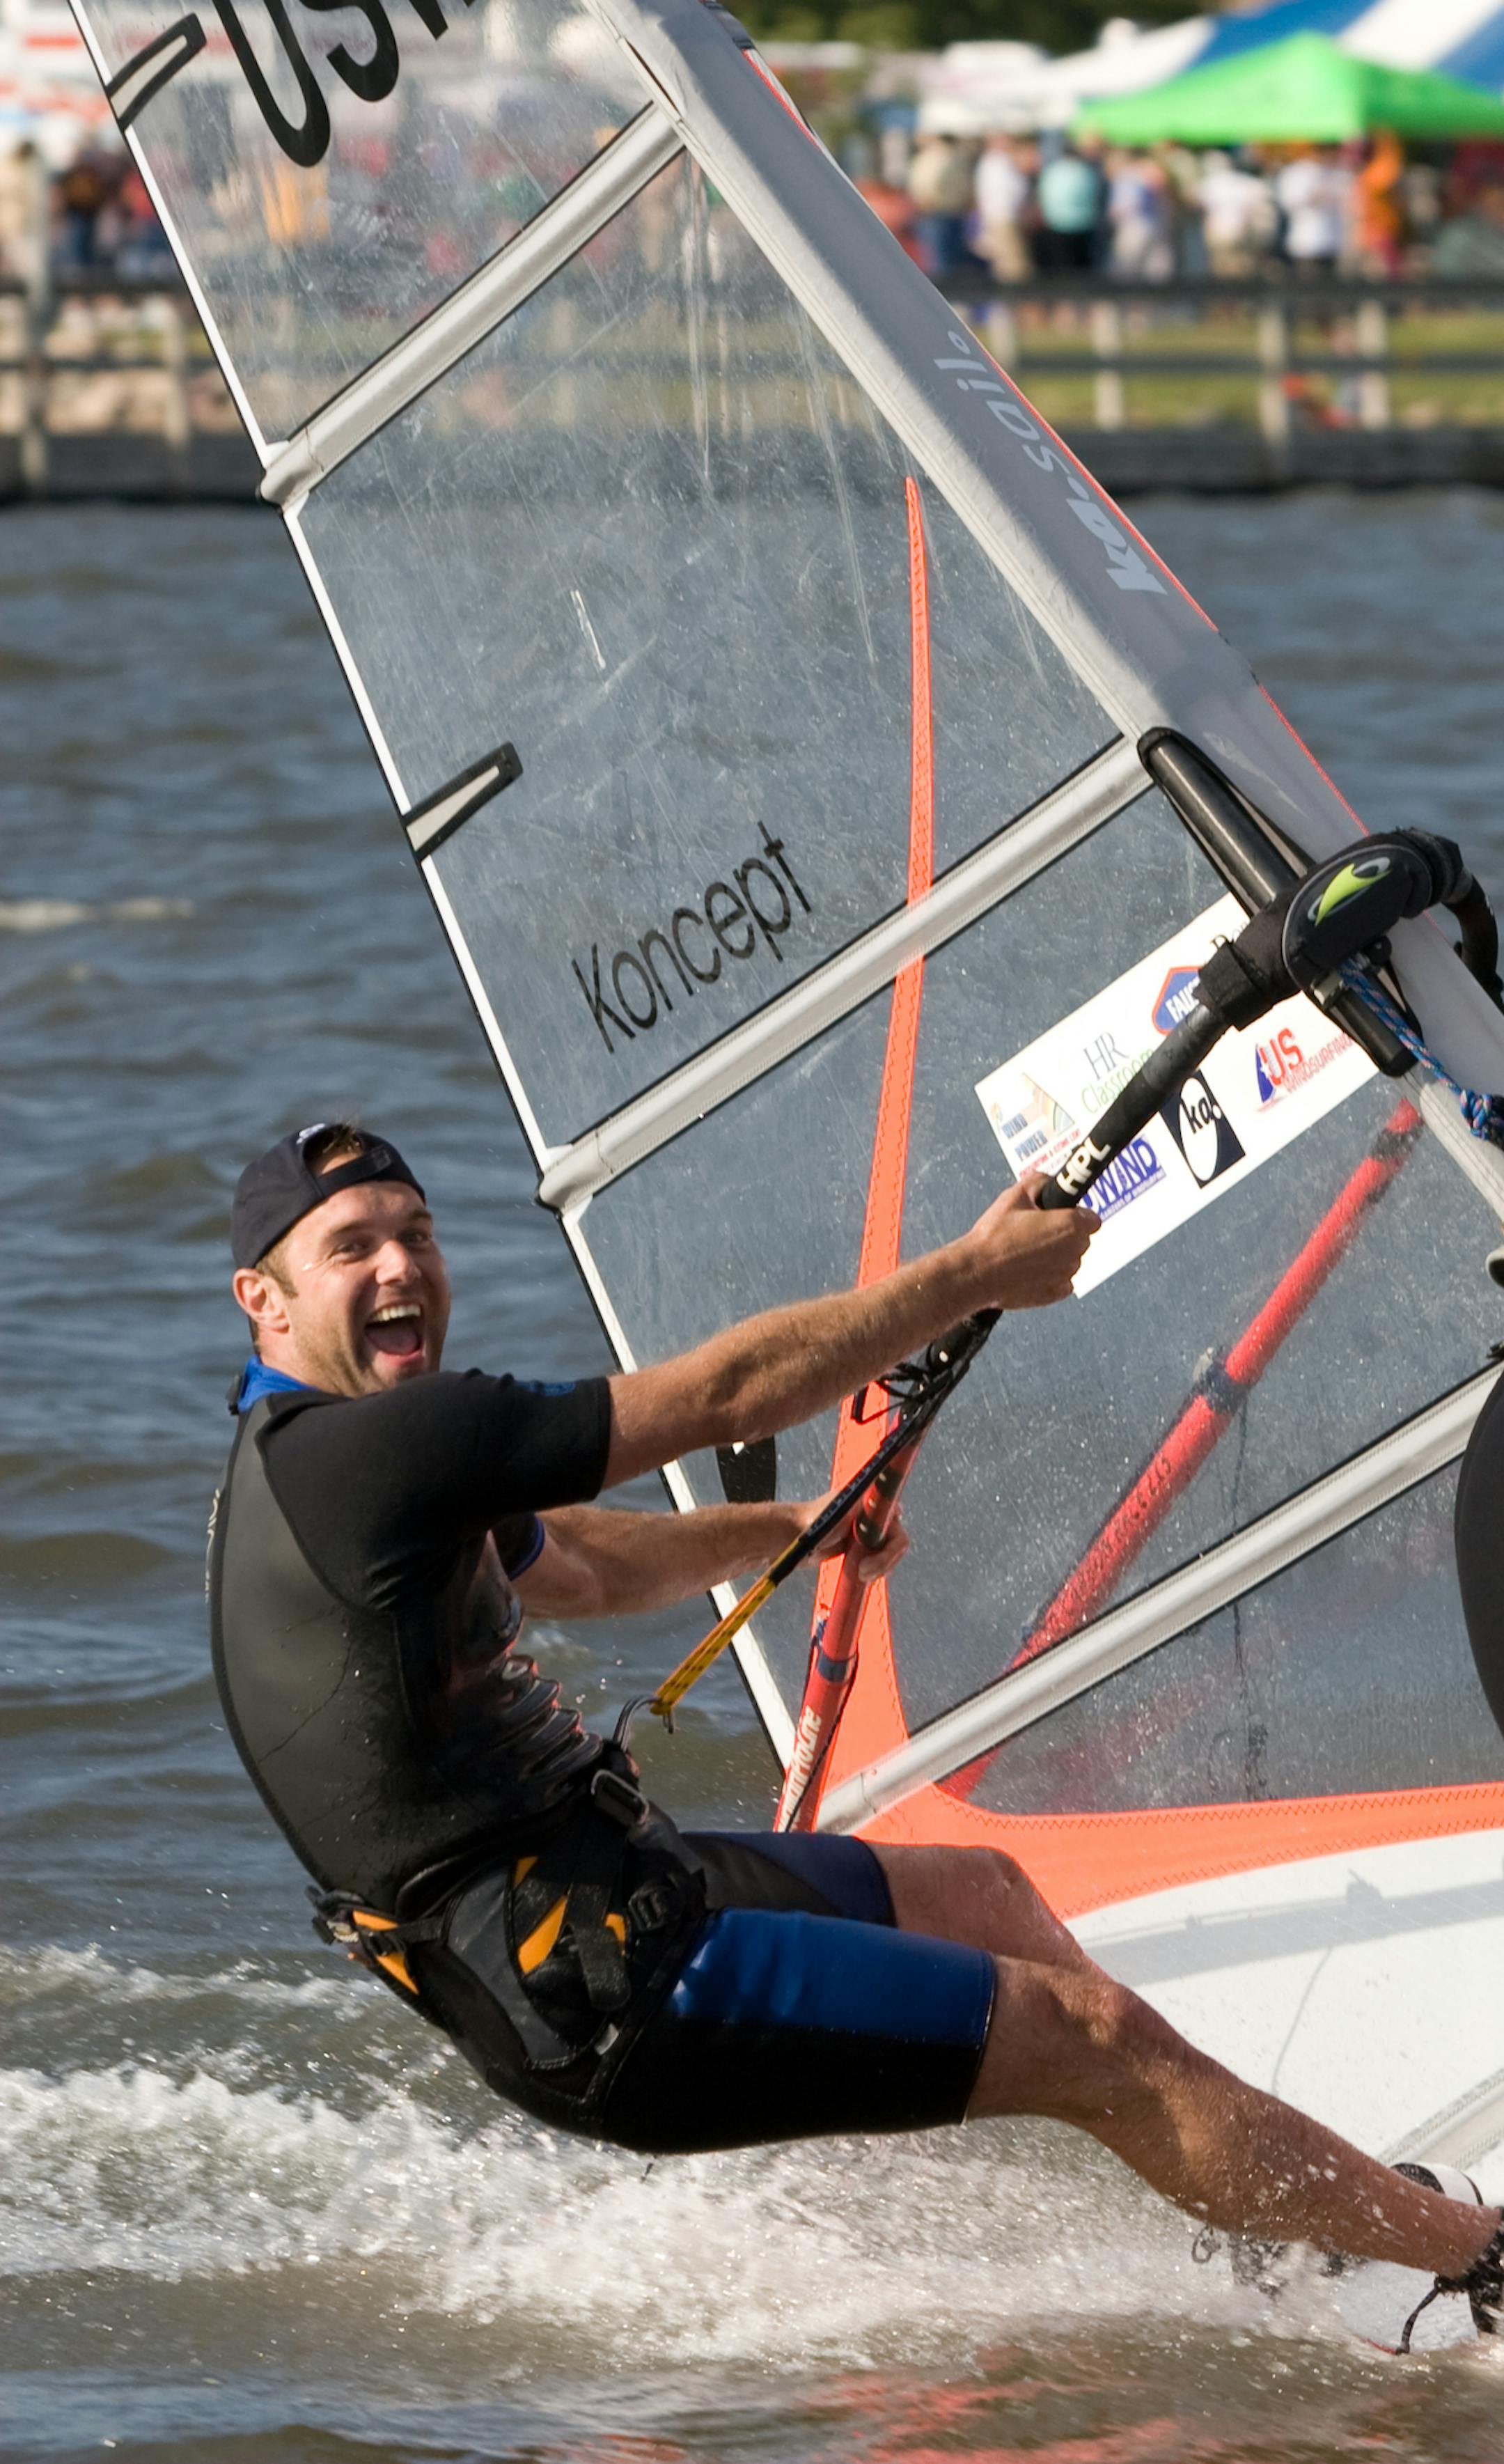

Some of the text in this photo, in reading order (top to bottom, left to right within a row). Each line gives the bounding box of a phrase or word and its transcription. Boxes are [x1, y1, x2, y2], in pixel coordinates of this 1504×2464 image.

[571, 820, 812, 1054] Koncept
[1082, 1031, 1131, 1081] HR
[1258, 1028, 1305, 1086] US
[1056, 1137, 1112, 1196] HPL
